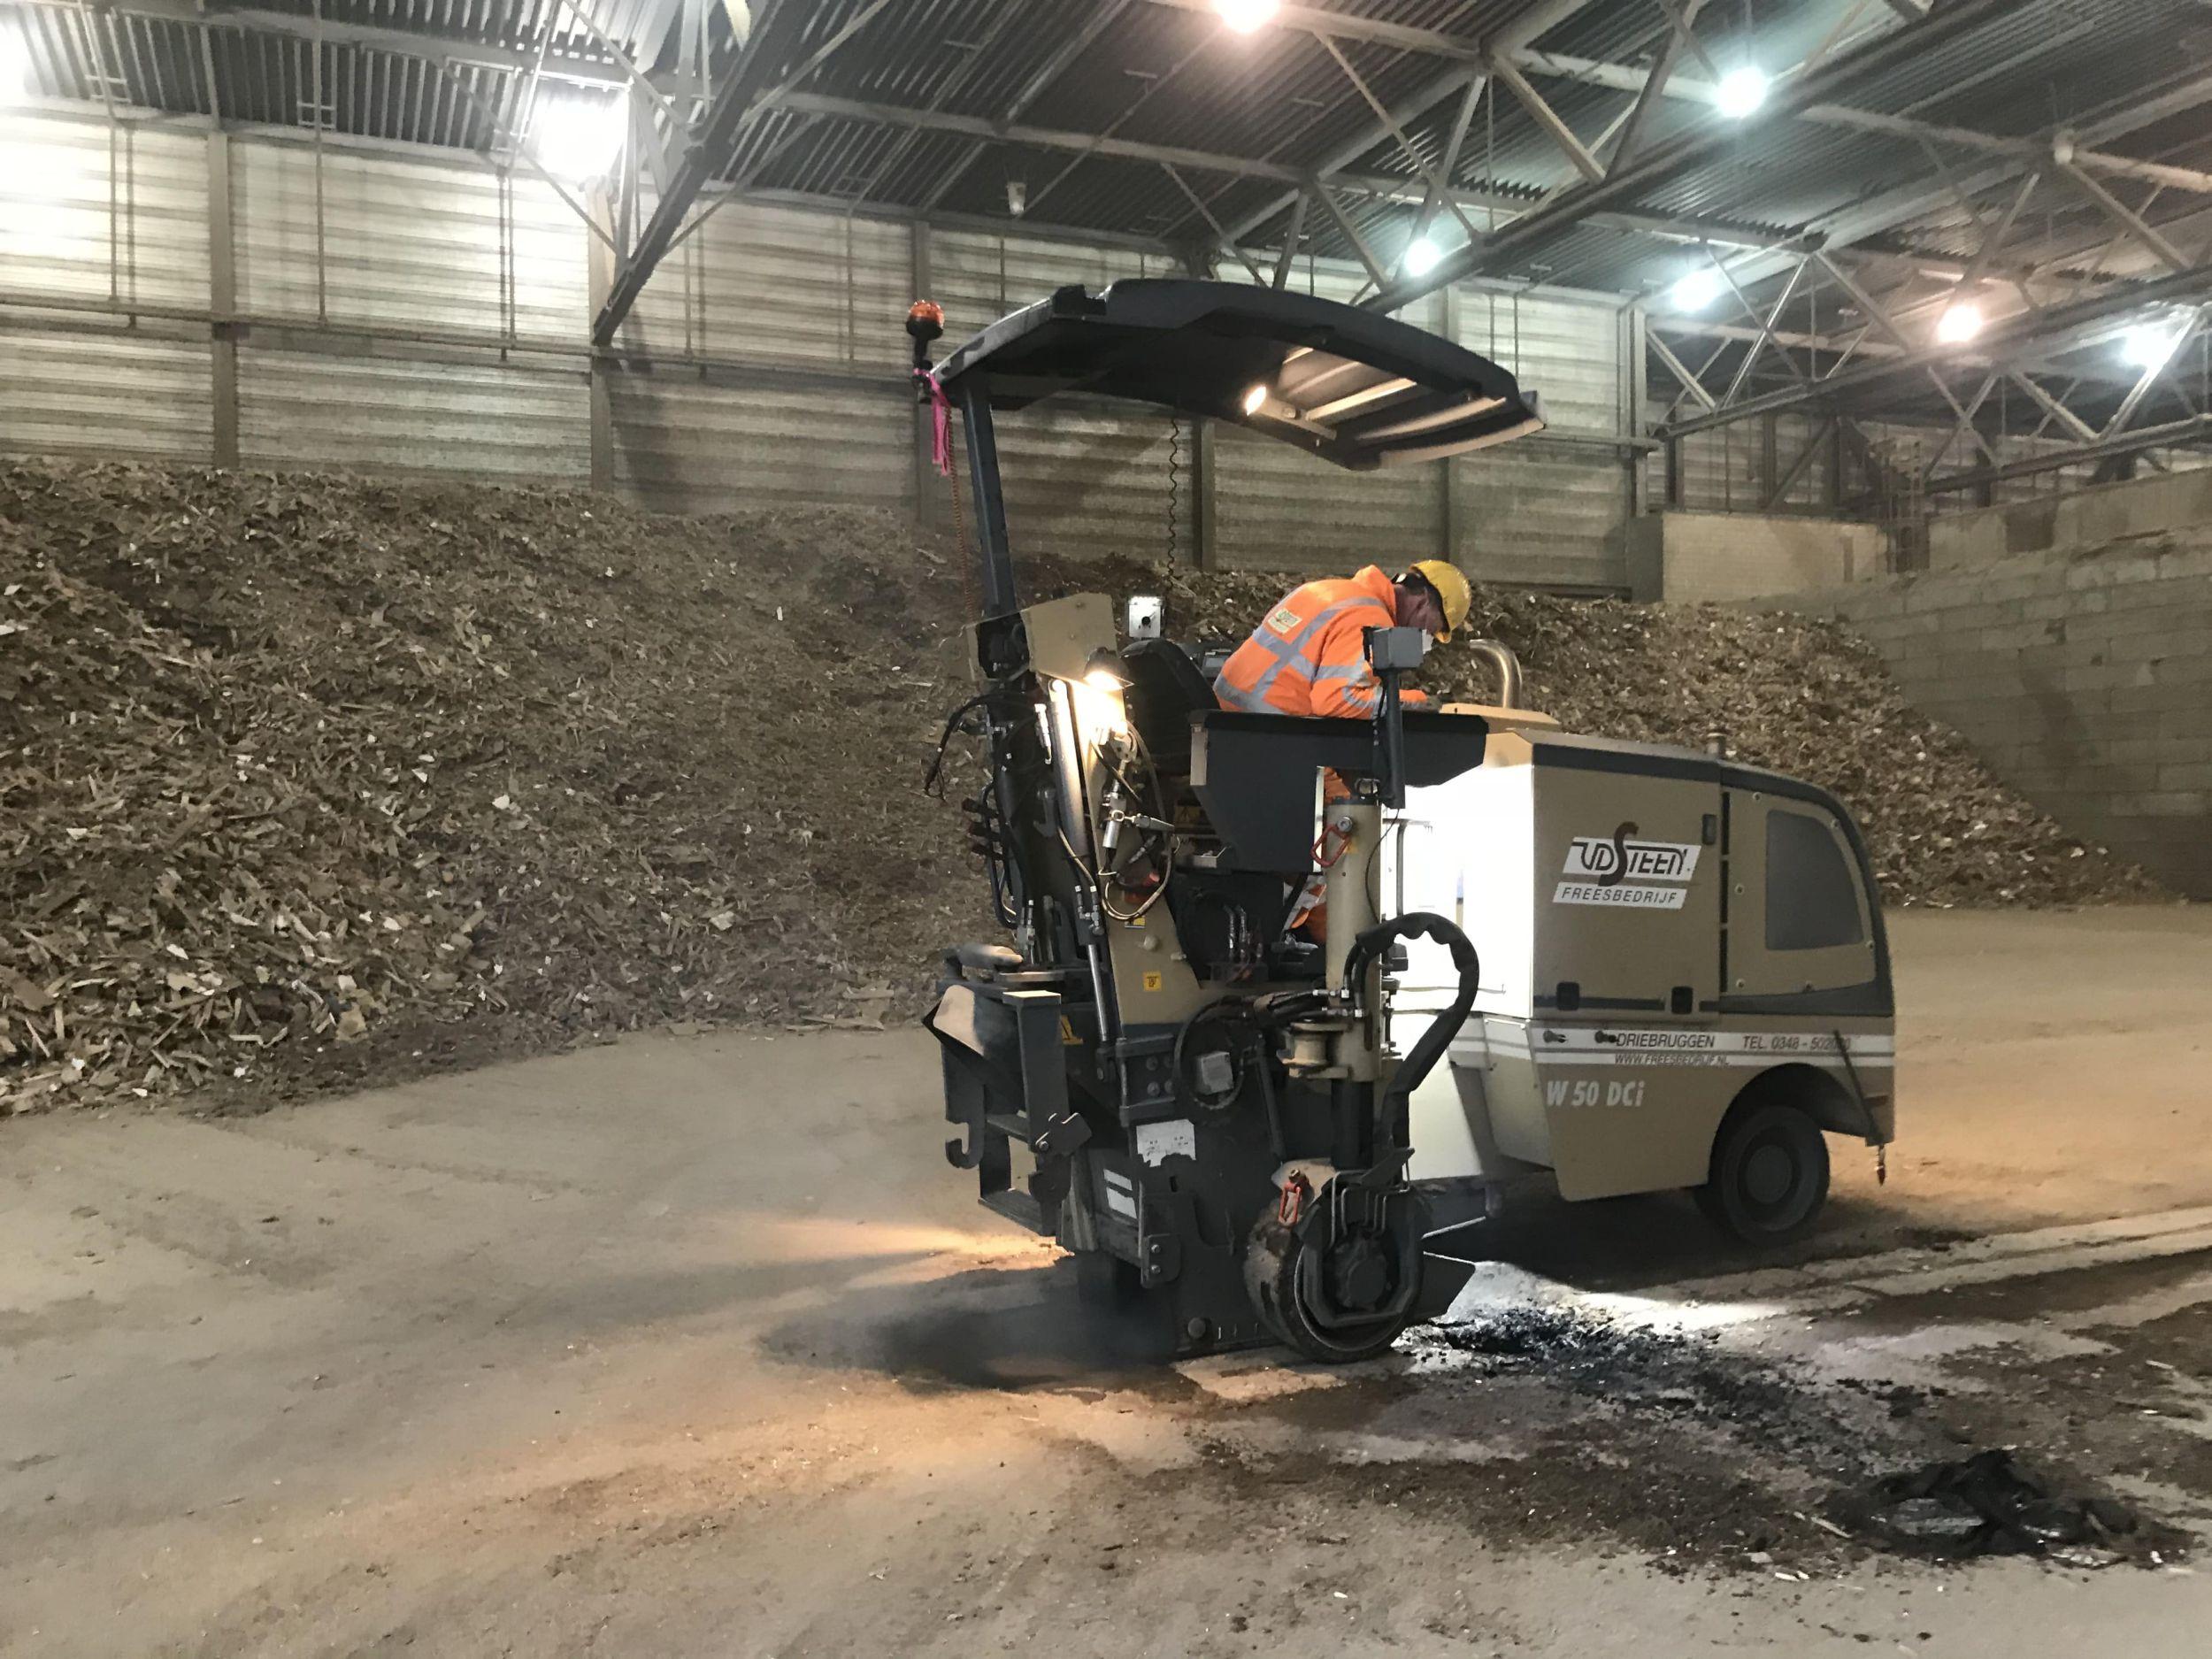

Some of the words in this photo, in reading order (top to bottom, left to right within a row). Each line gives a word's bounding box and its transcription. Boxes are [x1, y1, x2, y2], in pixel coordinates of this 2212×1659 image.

[1561, 887, 1678, 904] FREESBEDRIJF
[1617, 1033, 1716, 1048] DRIEBRUGGEN
[1547, 1080, 1570, 1106] W
[1571, 1080, 1600, 1106] 50
[1606, 1080, 1645, 1106] DCi
